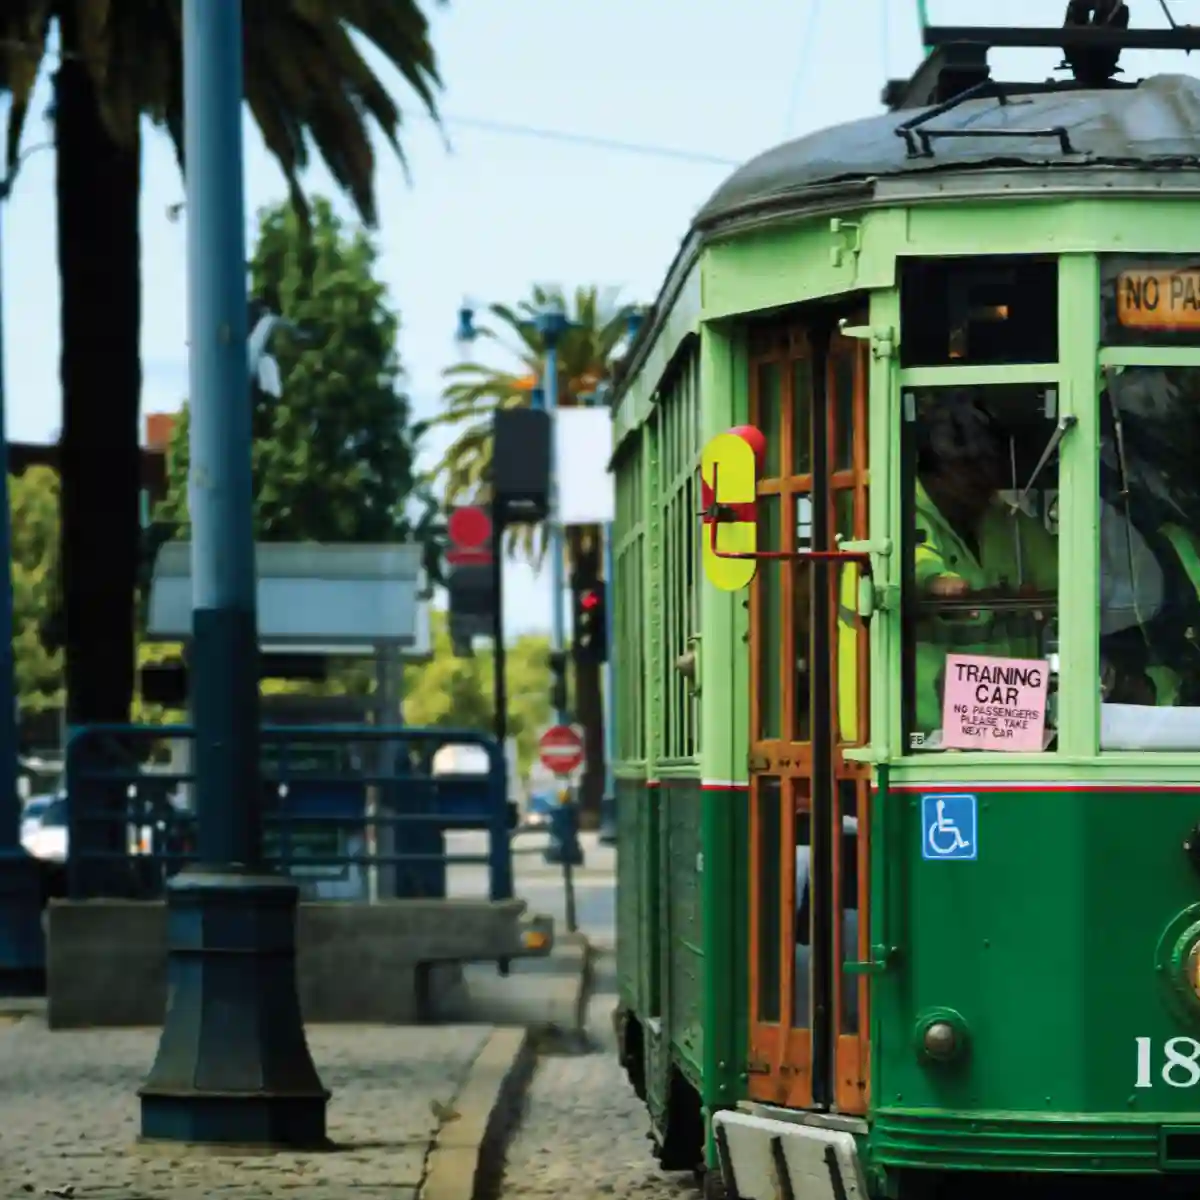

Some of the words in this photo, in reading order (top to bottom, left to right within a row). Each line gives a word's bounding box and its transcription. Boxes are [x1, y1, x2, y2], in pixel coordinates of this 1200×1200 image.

[1125, 275, 1159, 311] NO
[954, 663, 1041, 688] TRAINING
[975, 684, 1019, 706] CAR
[954, 703, 968, 713] NO
[973, 705, 1039, 720] PASSENGERS
[960, 715, 997, 727] PLEASE
[1004, 718, 1028, 730] TAKE
[962, 726, 988, 737] NEXT
[992, 728, 1013, 739] CAR
